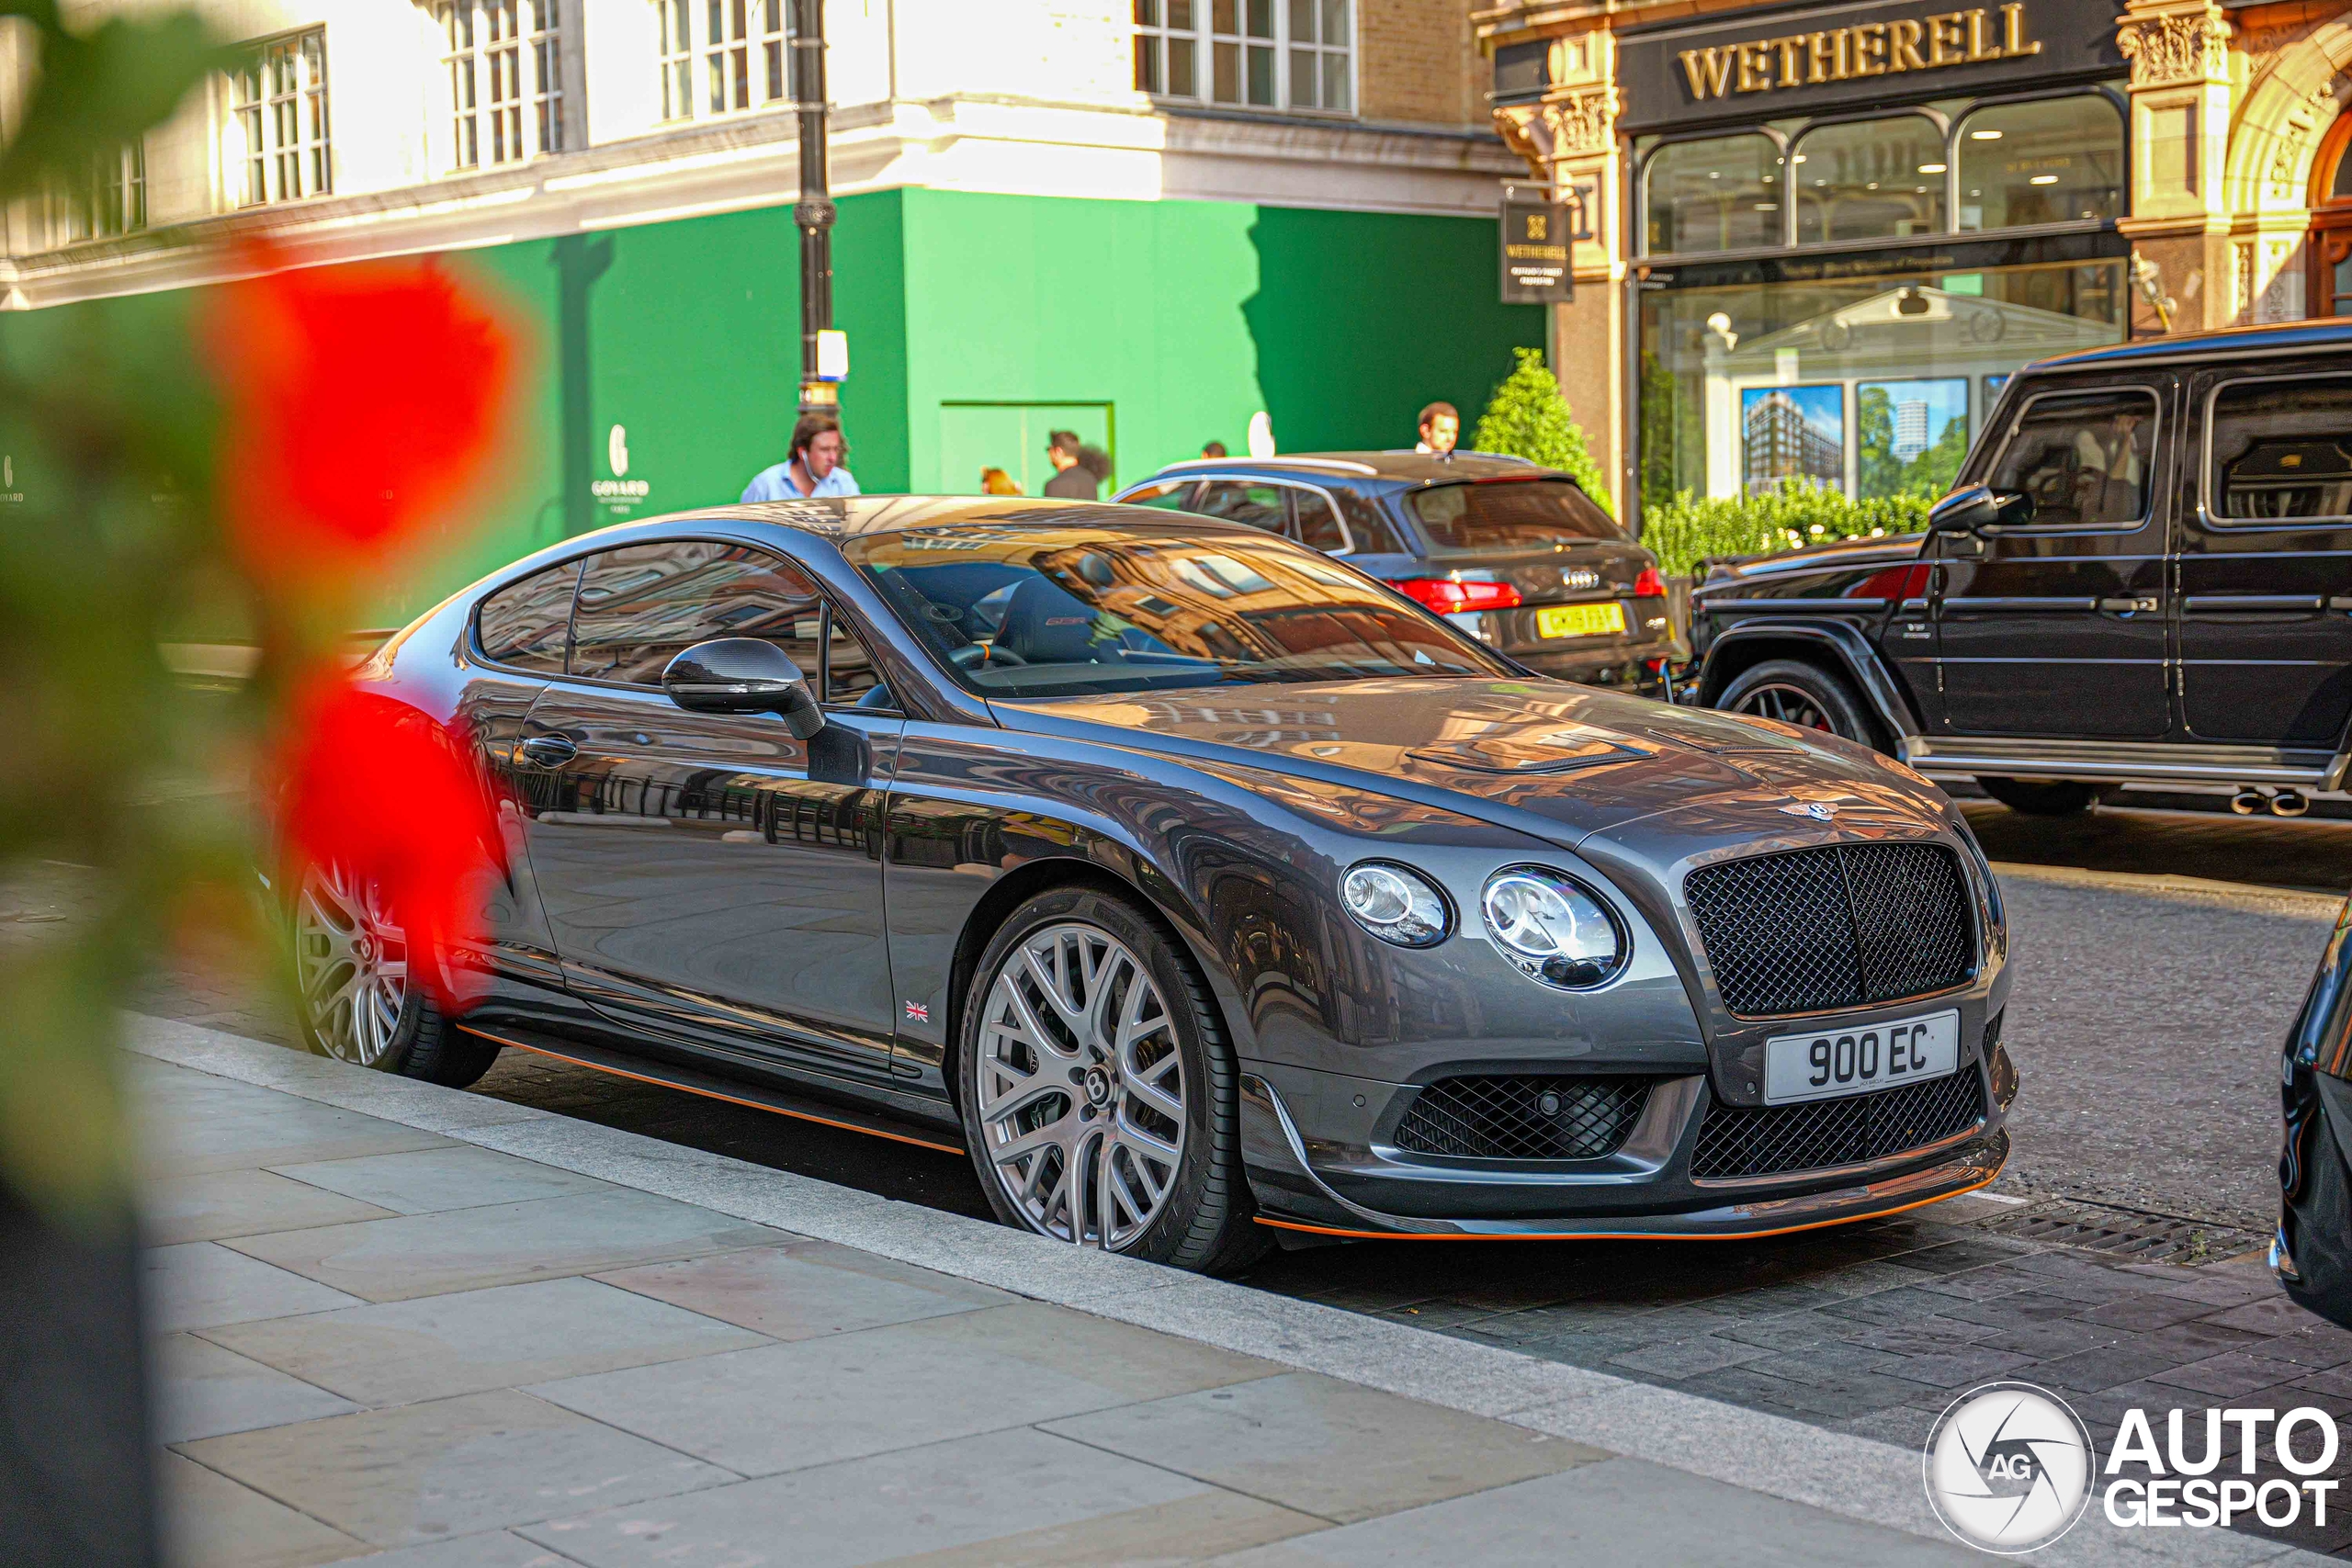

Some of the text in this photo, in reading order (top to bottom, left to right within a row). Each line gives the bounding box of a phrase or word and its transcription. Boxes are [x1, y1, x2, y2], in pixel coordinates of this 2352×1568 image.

[1678, 2, 2042, 100] WETHERELL
[0, 492, 24, 502] OYARD
[592, 480, 649, 496] GOYARD
[1809, 1023, 1928, 1087] 900 EC
